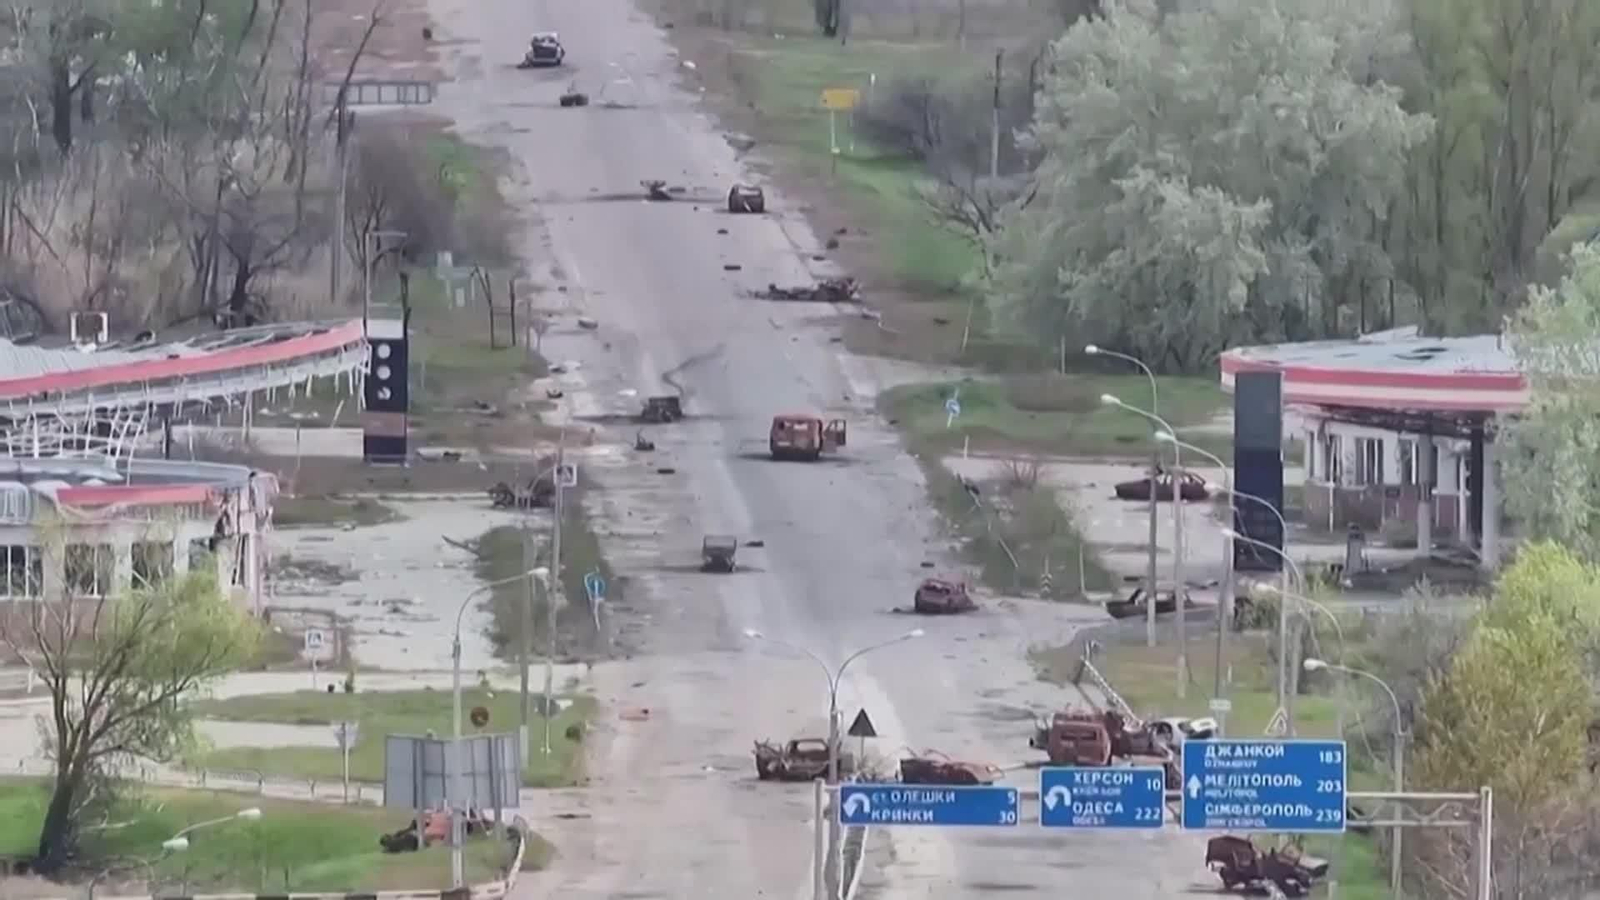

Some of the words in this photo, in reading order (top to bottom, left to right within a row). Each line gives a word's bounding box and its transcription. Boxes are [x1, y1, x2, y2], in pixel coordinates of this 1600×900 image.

[1204, 745, 1284, 758] ДЖАНКОЙ
[1319, 751, 1342, 764] 183
[1073, 772, 1133, 785] ХЕРСОН
[1146, 779, 1161, 791] 10
[1204, 773, 1302, 787] МЕЛІТОПОЛЬ
[1316, 780, 1342, 793] 203
[891, 791, 955, 804] ОЛЕШКИ
[1007, 792, 1016, 804] 5
[871, 809, 934, 822] КРИНКИ
[999, 811, 1016, 823] 30
[1072, 801, 1124, 816] ОДЕСА
[1134, 808, 1160, 820] 222
[1205, 803, 1313, 817] СІМФЕРОПОЛЬ
[1315, 810, 1342, 822] 239
